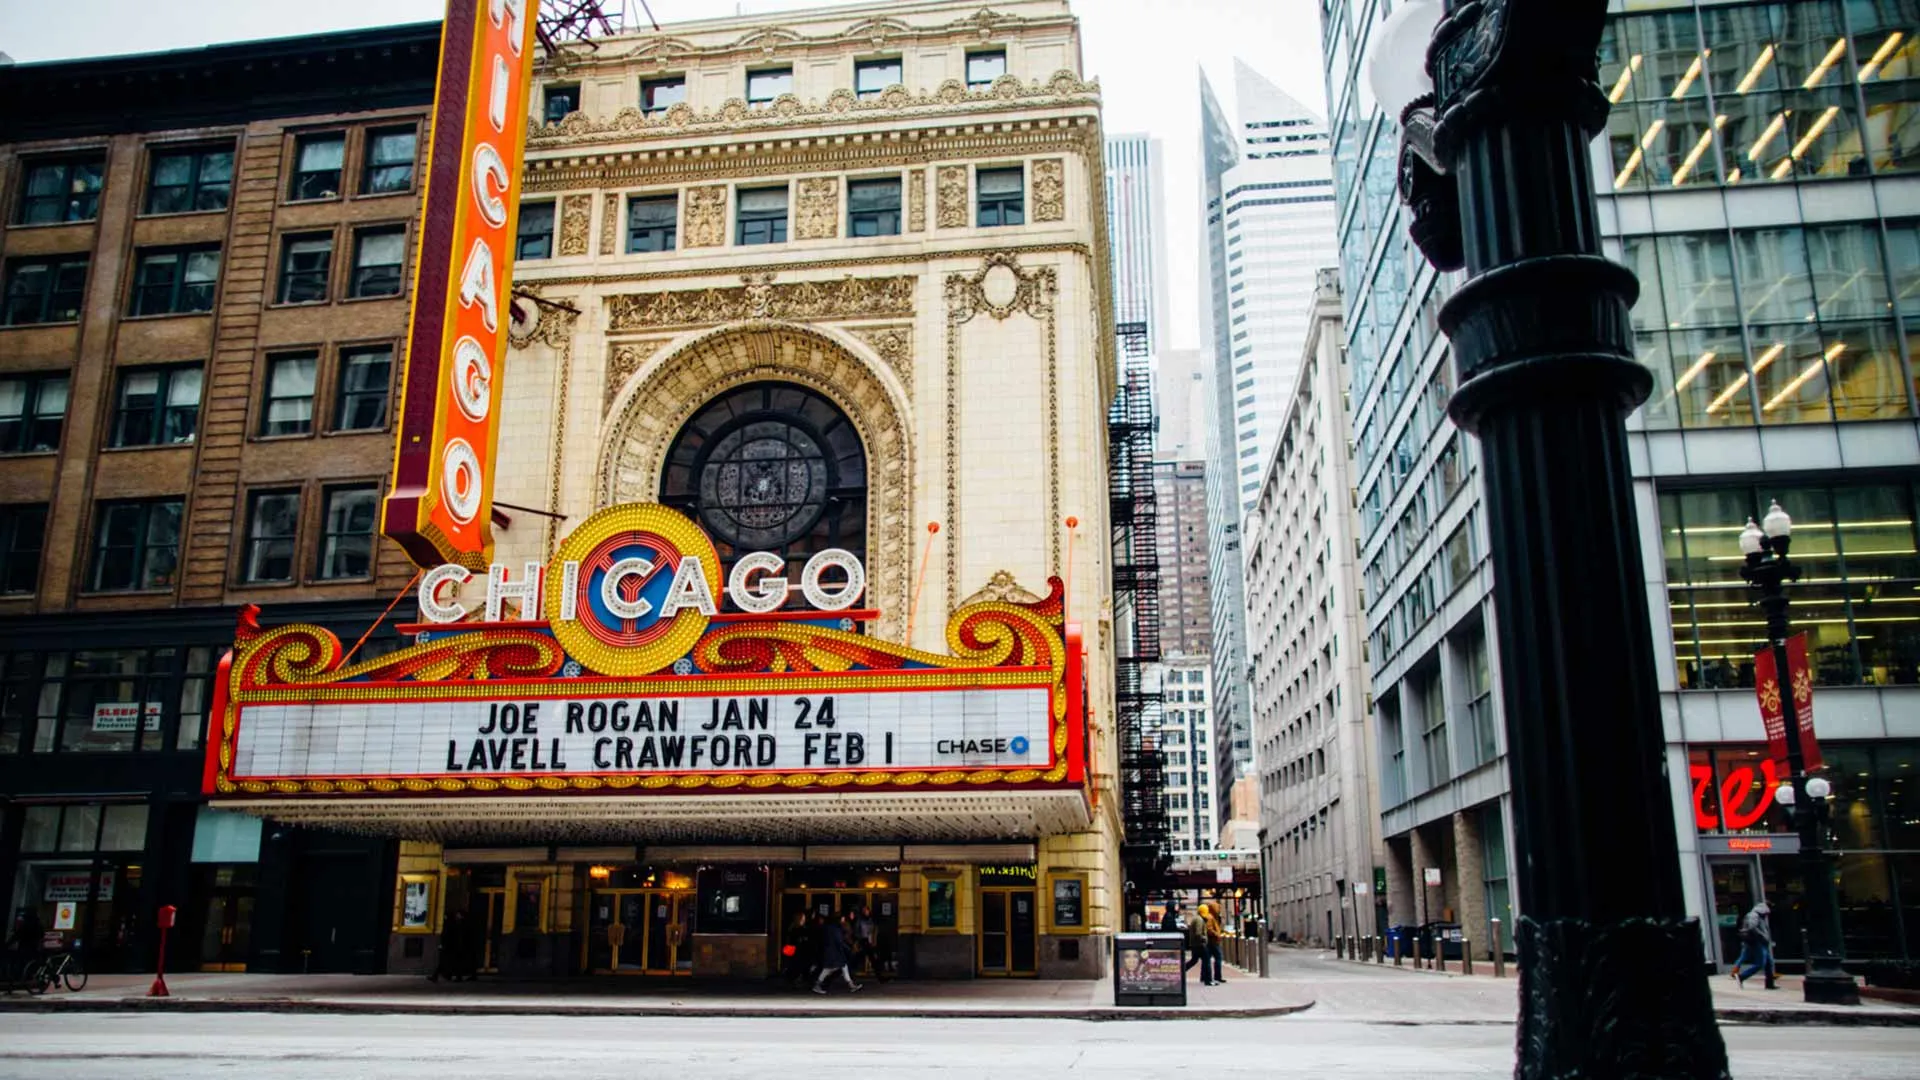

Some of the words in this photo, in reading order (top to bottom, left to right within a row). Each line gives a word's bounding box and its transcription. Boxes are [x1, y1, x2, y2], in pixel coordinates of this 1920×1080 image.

[418, 548, 865, 623] CHICAGO
[478, 702, 540, 734] JOE
[566, 700, 679, 733] ROGAN
[701, 698, 769, 730] JAN
[794, 697, 836, 729] 24
[447, 738, 567, 770] LAVELL
[593, 732, 776, 768] CRAWFORD
[803, 732, 865, 766] FEB
[937, 738, 1007, 754] CHASE
